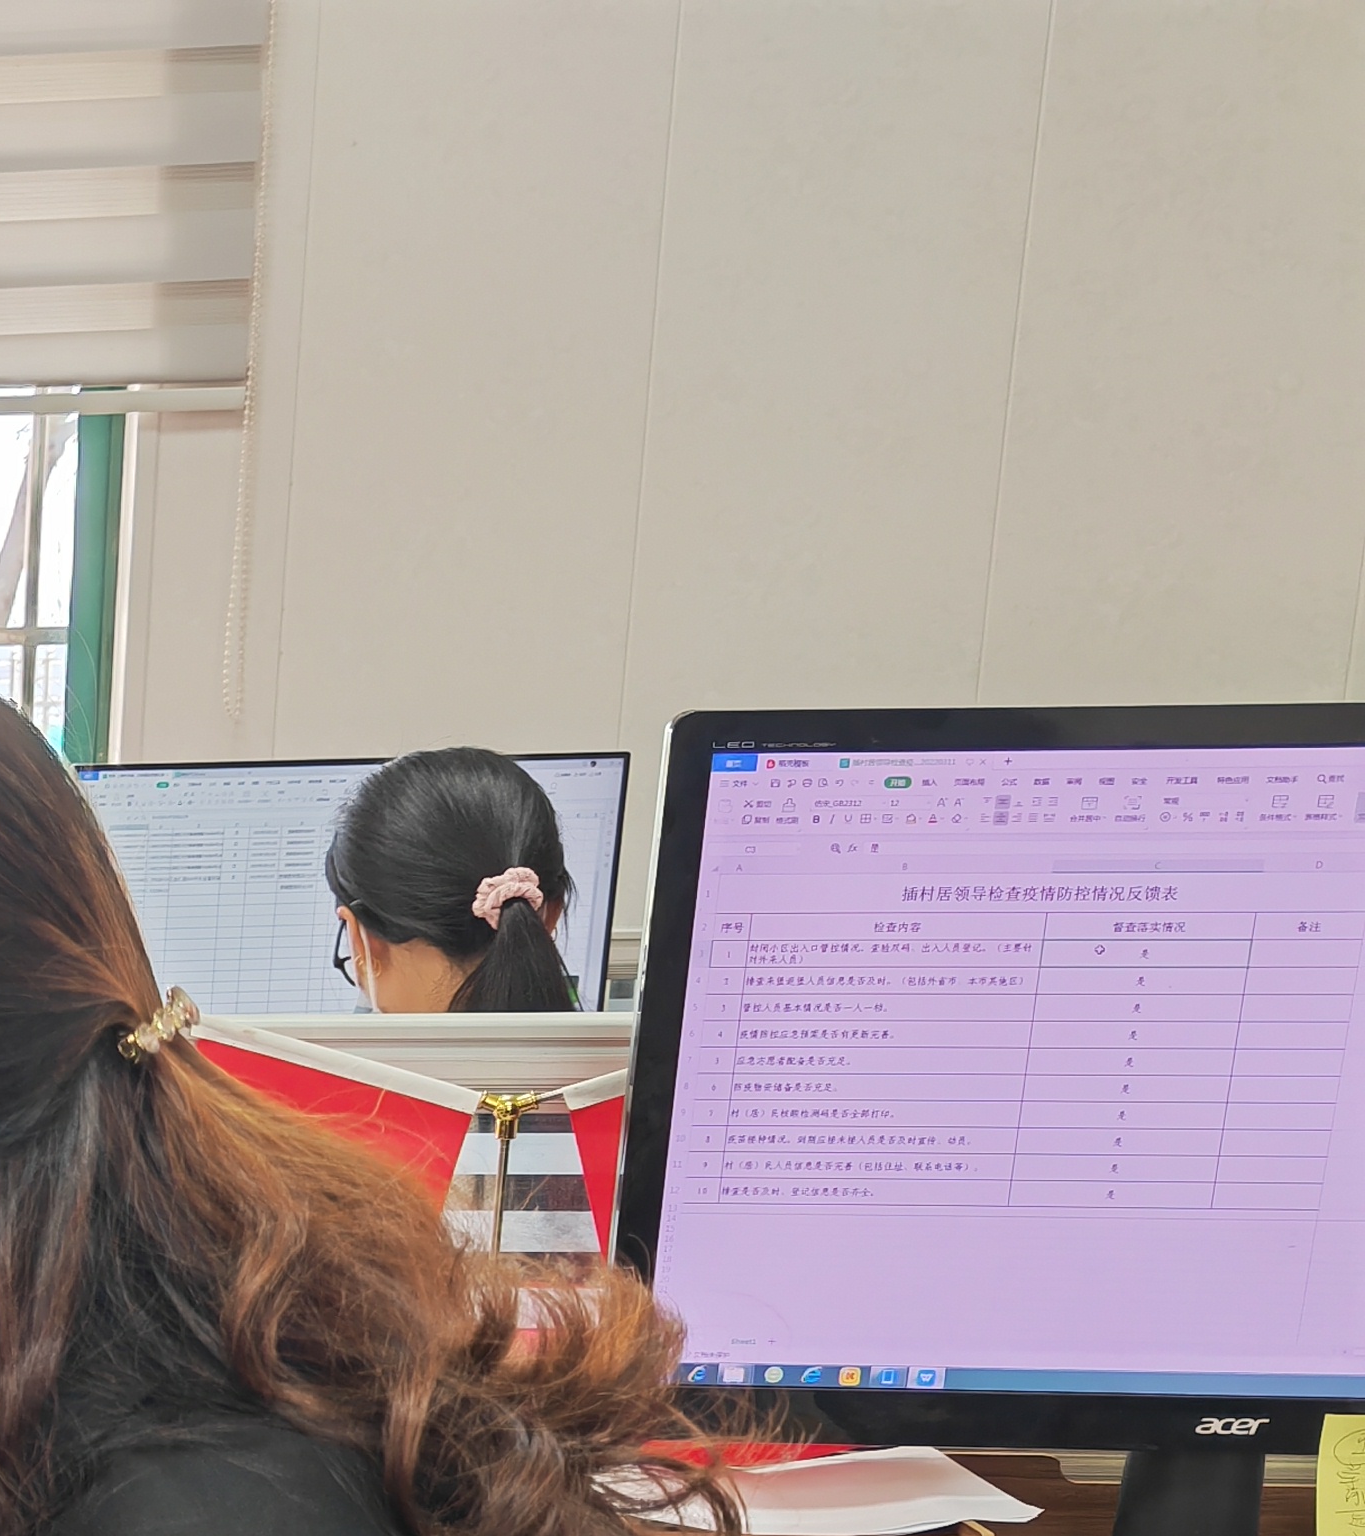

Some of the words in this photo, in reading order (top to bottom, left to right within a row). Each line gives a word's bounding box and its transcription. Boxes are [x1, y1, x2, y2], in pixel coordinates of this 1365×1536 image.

[1001, 778, 1017, 787] 公式
[1033, 778, 1050, 786] 数据
[1131, 777, 1148, 786] 安全
[1166, 777, 1198, 786] 开发工具
[1217, 776, 1250, 785] 特色应用
[901, 885, 1179, 902] 插村居领导检查疫情防控情况反馈表
[720, 922, 744, 933] 序号
[873, 921, 921, 933] 检查内容
[1113, 921, 1186, 933] 督查落实情况
[1297, 921, 1321, 933] 备注
[1139, 949, 1150, 960] 是
[1135, 976, 1146, 987] 是
[1131, 1003, 1142, 1014] 是
[1127, 1030, 1138, 1041] 是
[1124, 1057, 1135, 1068] 是
[1120, 1084, 1131, 1095] 是
[1116, 1110, 1127, 1121] 是
[1112, 1137, 1123, 1148] 是
[1109, 1163, 1120, 1174] 是
[1106, 1190, 1117, 1200] 是
[1195, 1417, 1270, 1436] acer
